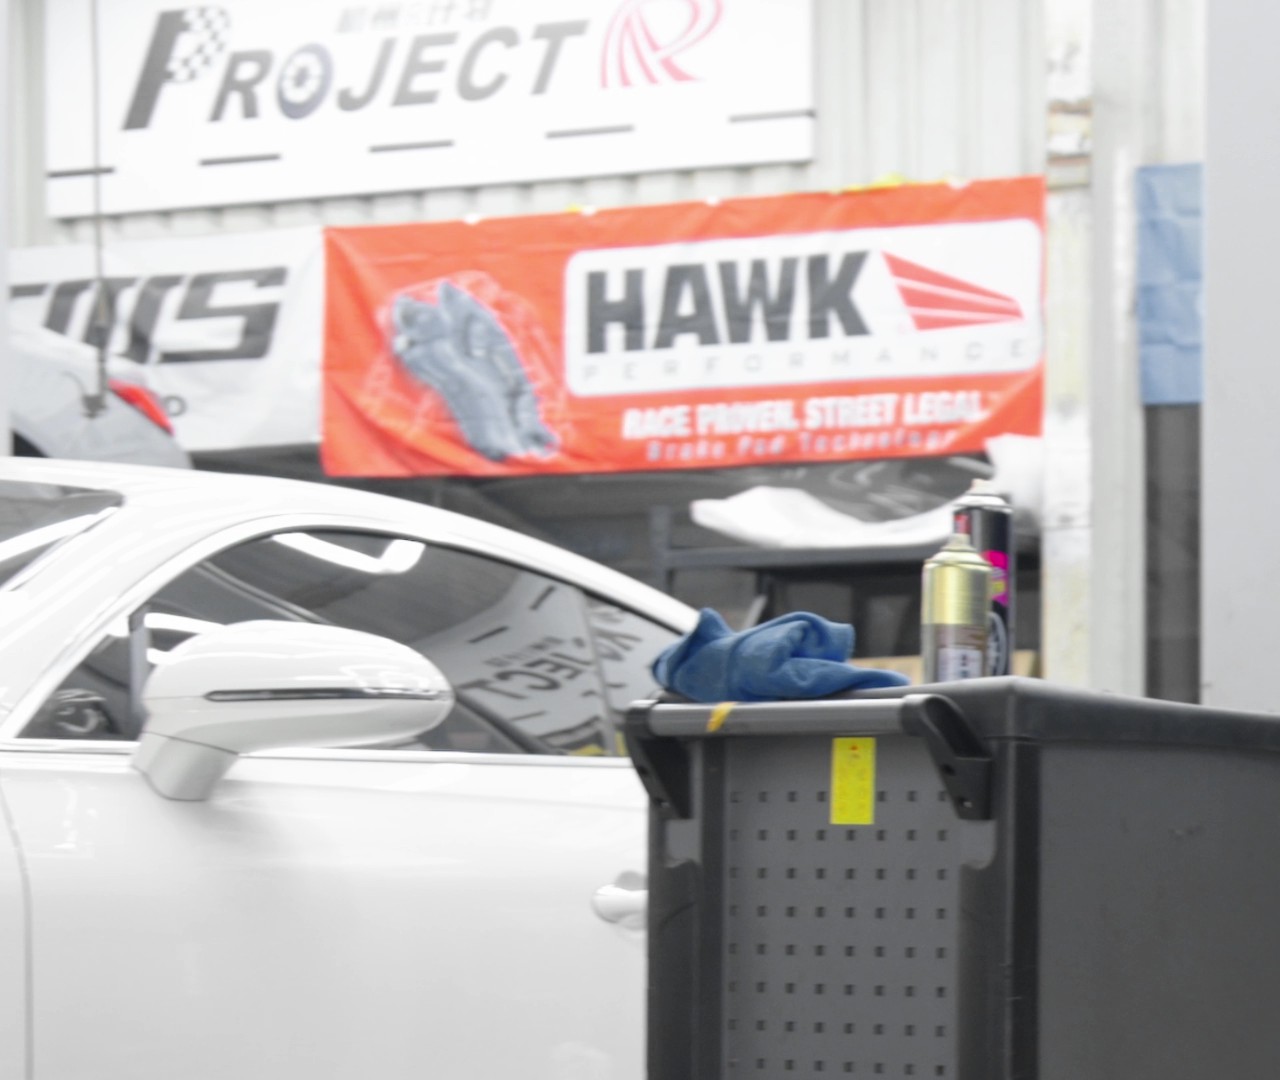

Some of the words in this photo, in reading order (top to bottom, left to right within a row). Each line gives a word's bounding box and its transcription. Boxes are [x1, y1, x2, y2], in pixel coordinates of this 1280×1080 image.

[122, 7, 590, 129] PROJECT
[586, 250, 873, 354] HAWK
[582, 338, 1026, 381] PERFORMANCE
[621, 407, 690, 439] RACE
[804, 392, 899, 429] STREET
